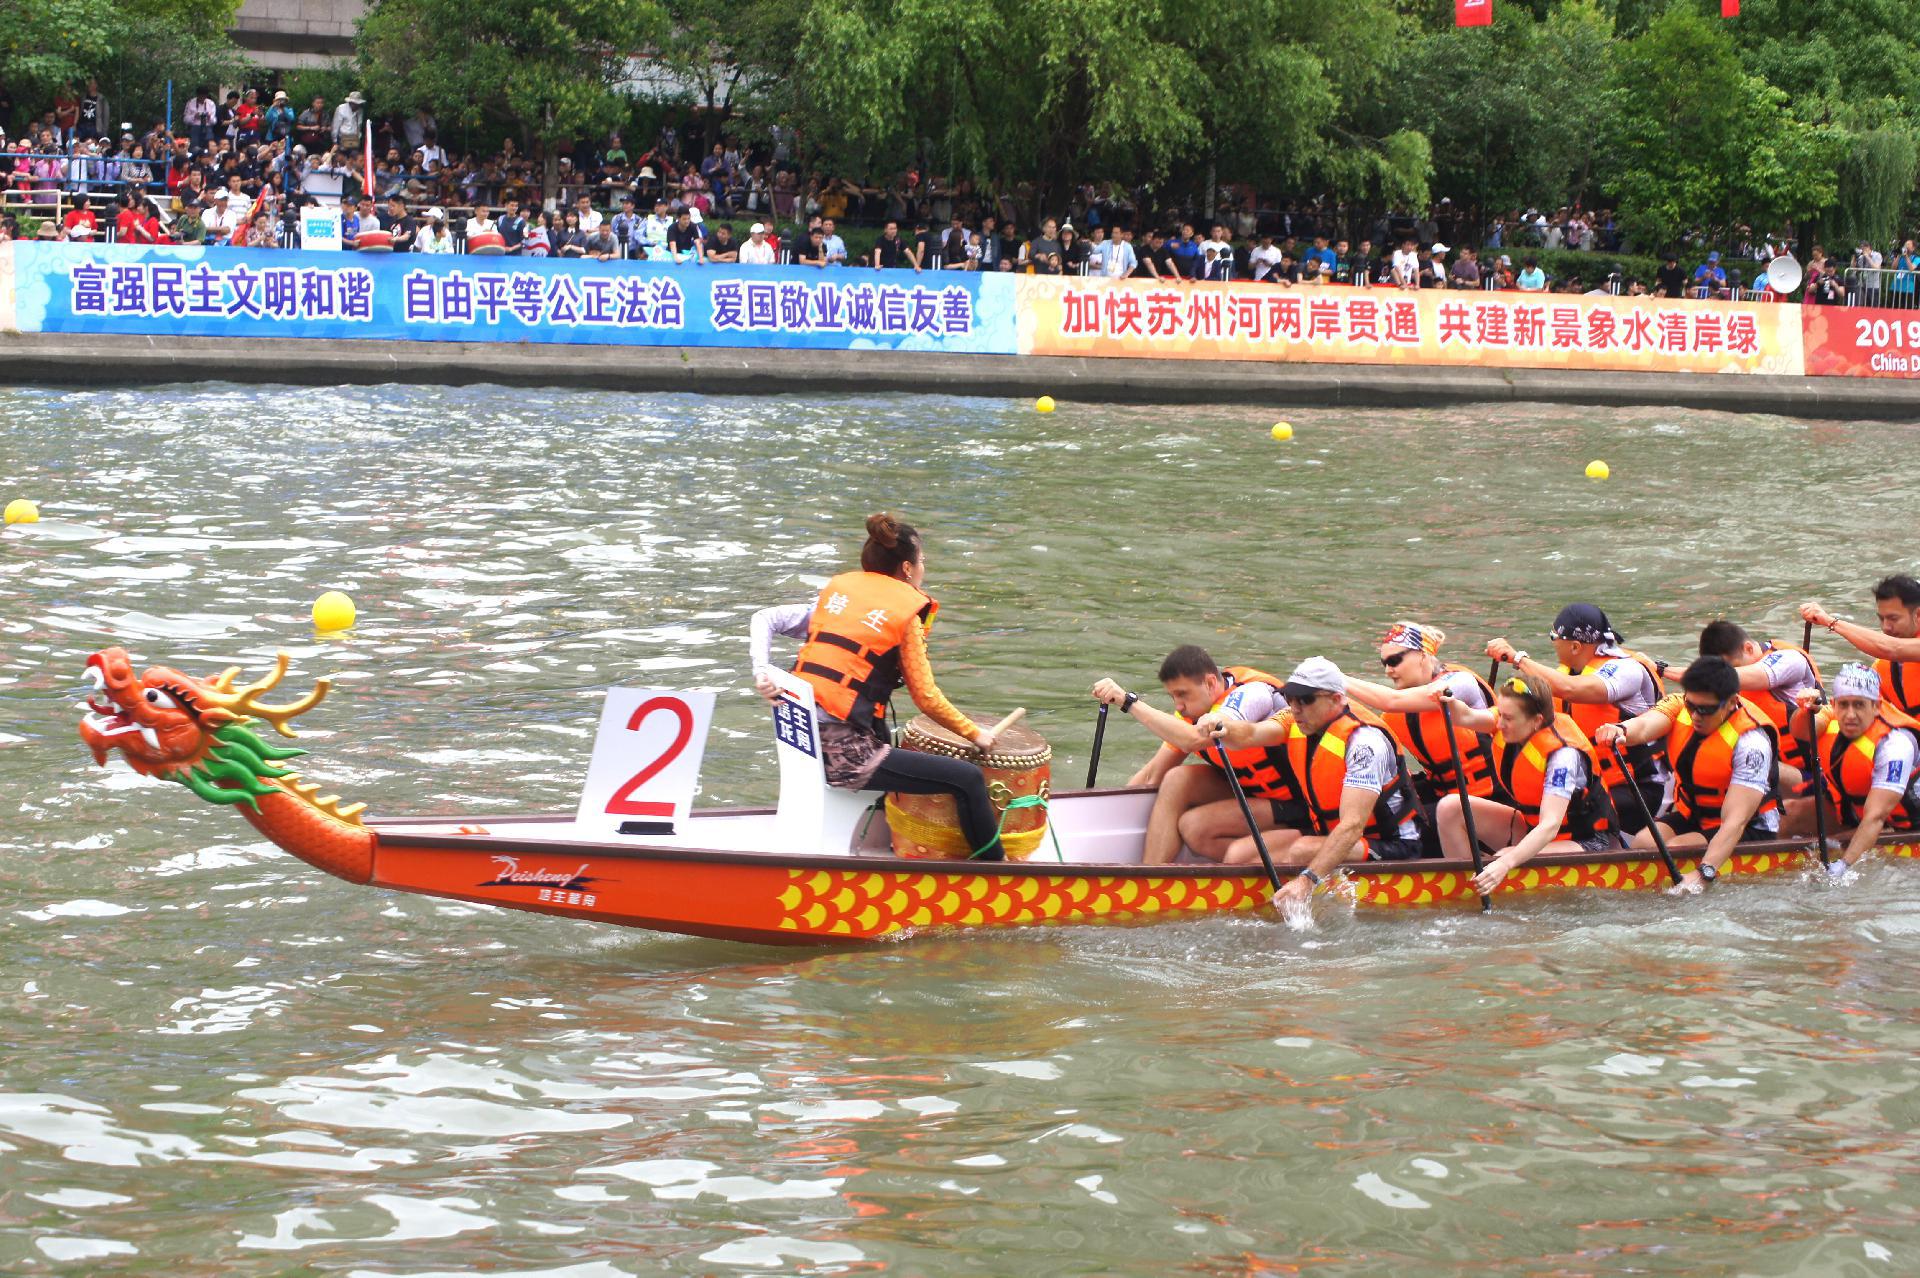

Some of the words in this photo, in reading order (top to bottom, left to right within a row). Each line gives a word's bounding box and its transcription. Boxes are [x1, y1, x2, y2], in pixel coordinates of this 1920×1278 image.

[73, 263, 371, 318] 富强民主文明和谐
[407, 273, 682, 326] 自由平等公正法治
[714, 283, 970, 333] 爱国敬业诚信友善
[1062, 290, 1420, 343] 加快苏州河两岸贯通
[1439, 303, 1758, 354] 共建新景象水清岸绿
[1855, 318, 1920, 348] 2019
[1871, 353, 1908, 371] China
[604, 696, 694, 817] 2
